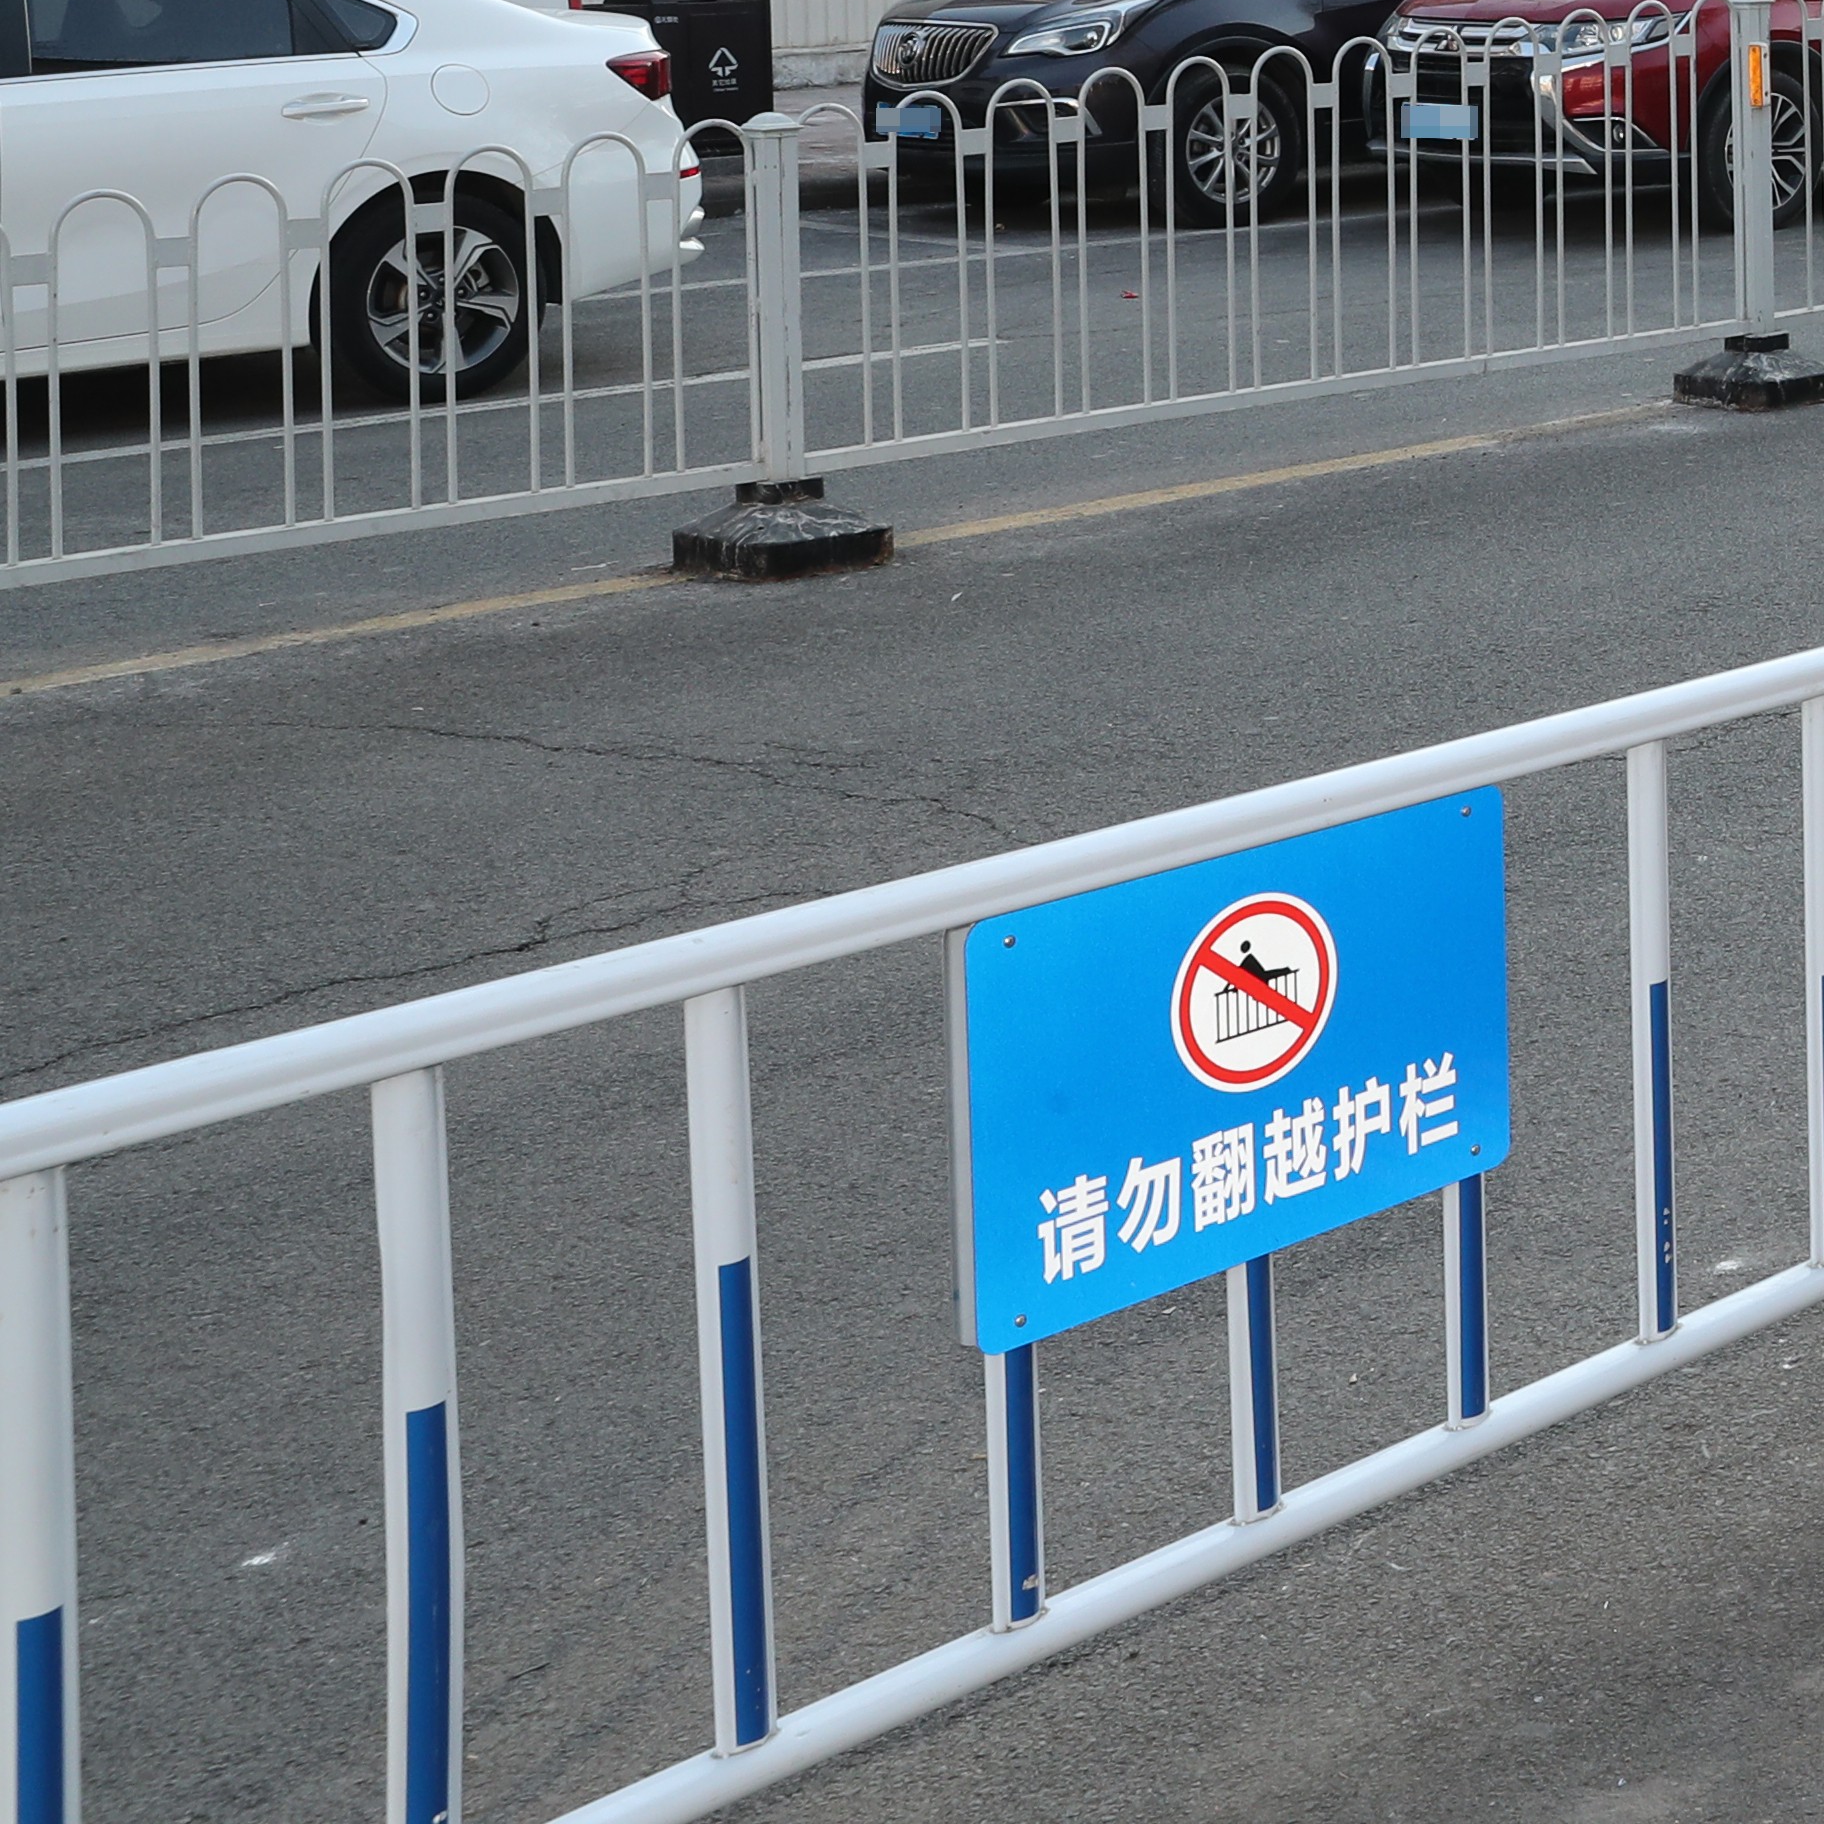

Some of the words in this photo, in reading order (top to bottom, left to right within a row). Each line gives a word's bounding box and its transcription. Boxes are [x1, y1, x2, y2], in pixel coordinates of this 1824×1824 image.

[1036, 1051, 1460, 1286] 请勿翻越护栏
